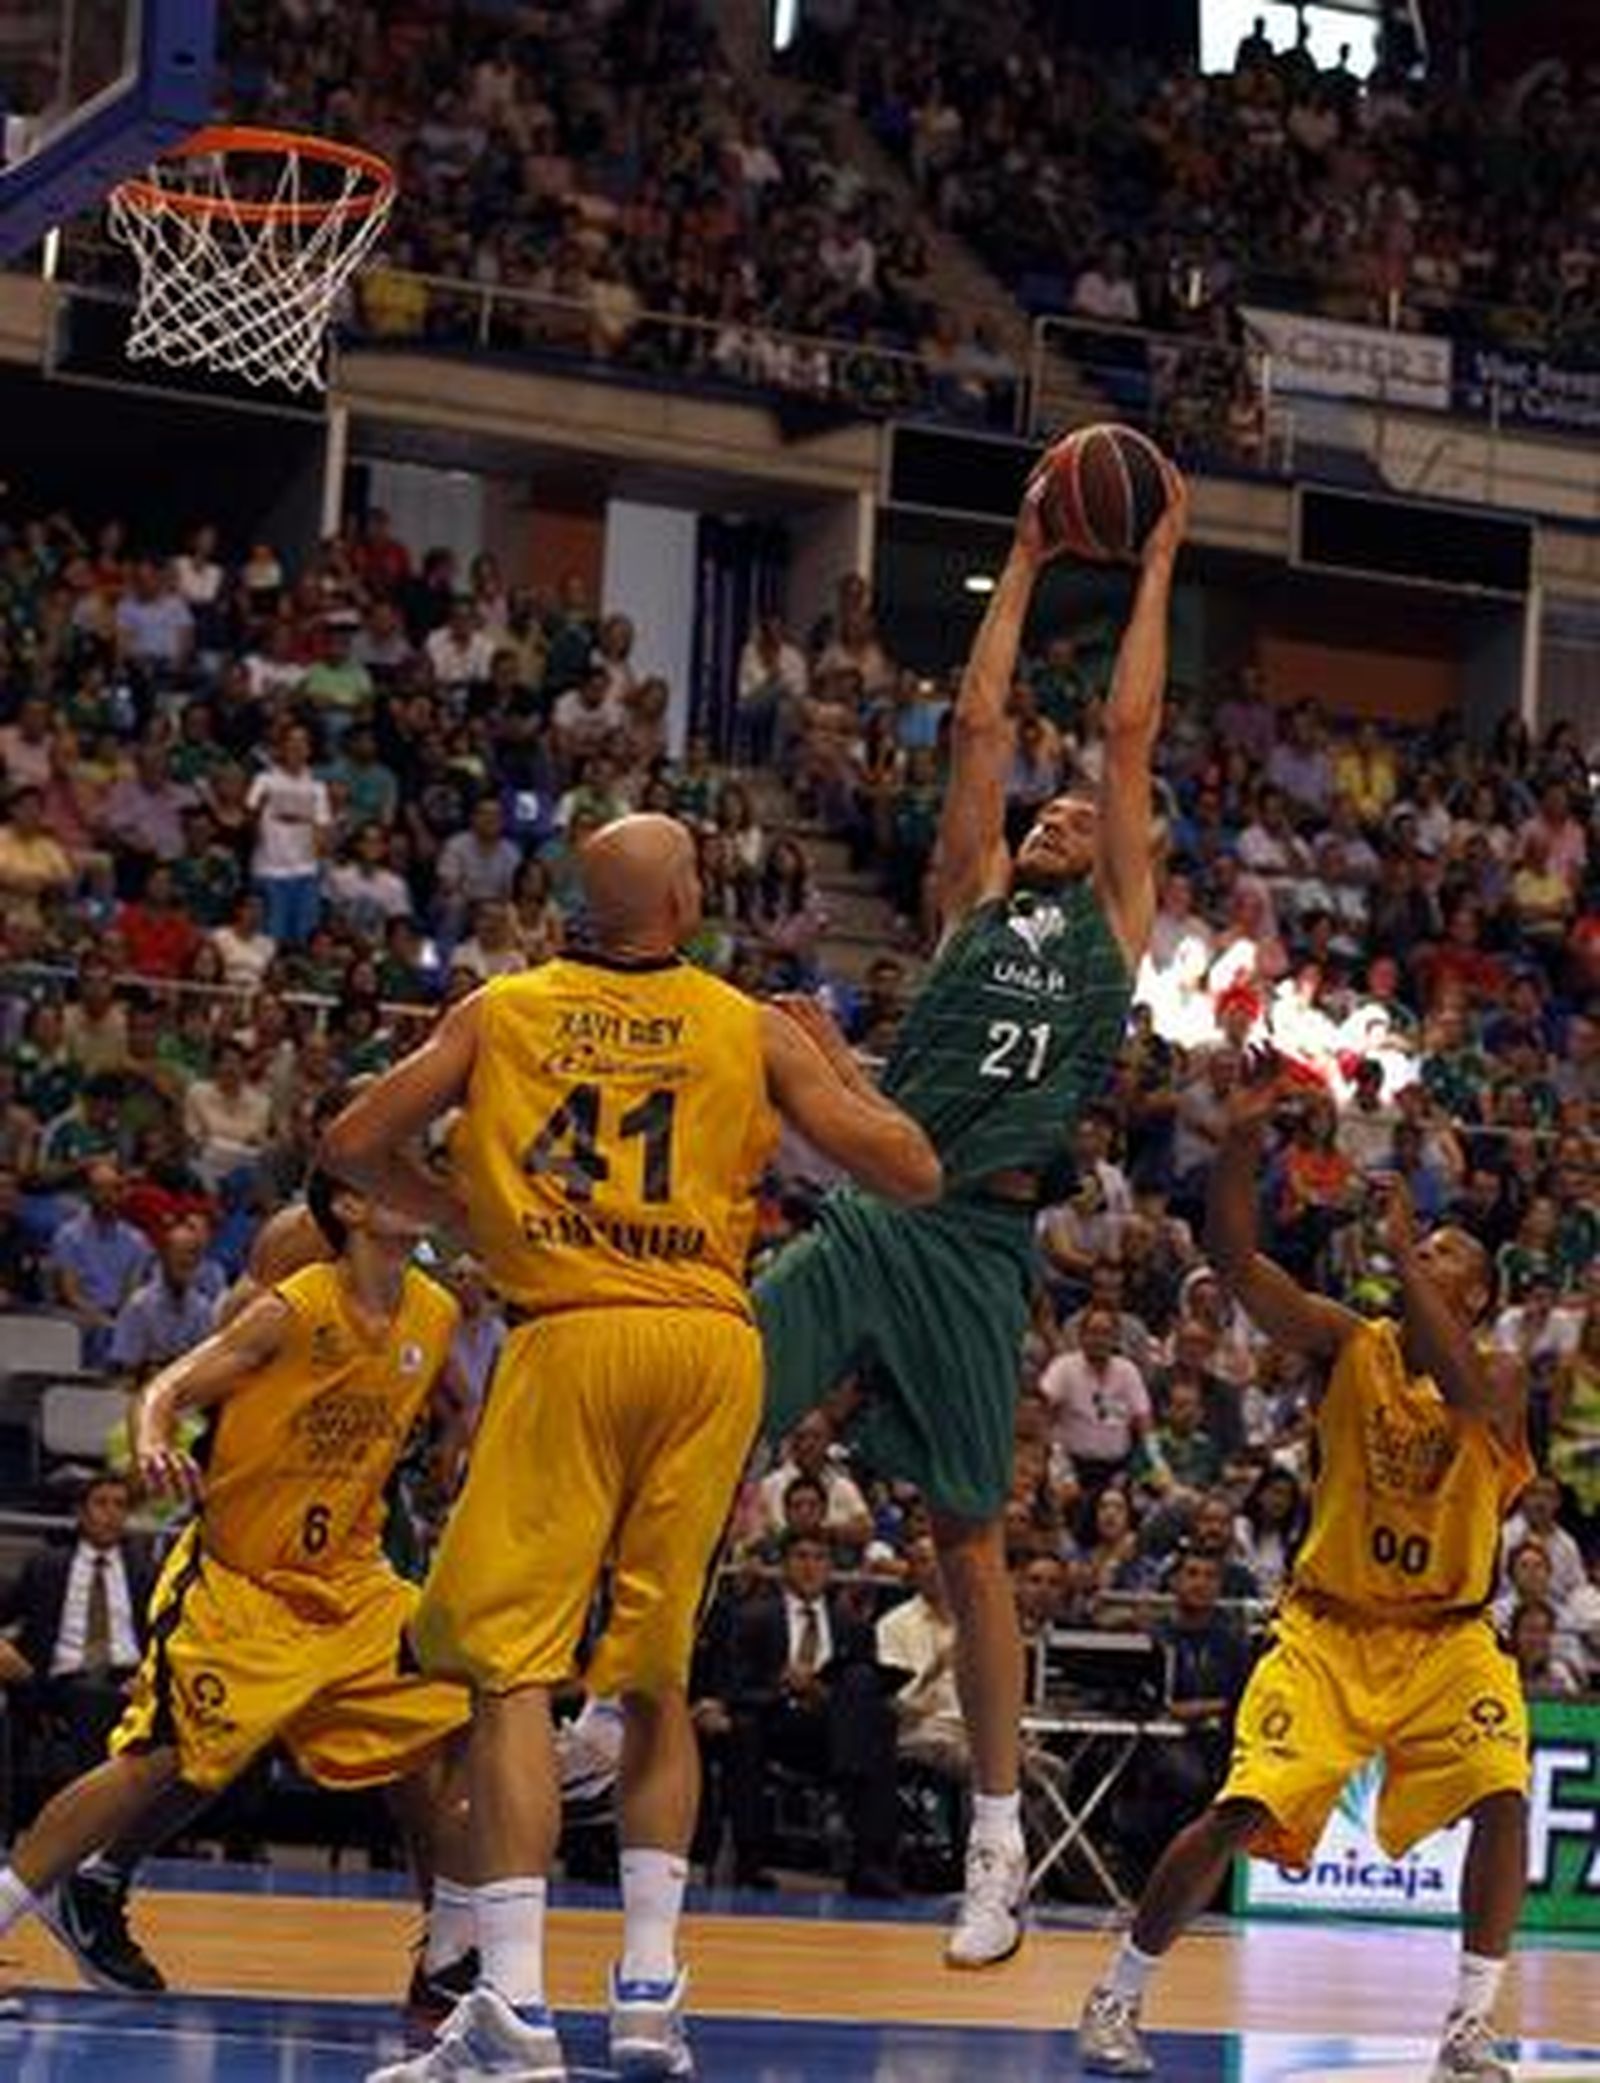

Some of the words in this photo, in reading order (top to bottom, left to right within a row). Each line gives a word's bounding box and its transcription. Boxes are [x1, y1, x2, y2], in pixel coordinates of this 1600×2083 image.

[979, 1021, 1051, 1081] 21
[522, 1083, 676, 1203] 41
[303, 1504, 332, 1555] 6
[1372, 1525, 1431, 1576] 00
[1526, 1748, 1600, 1888] F
